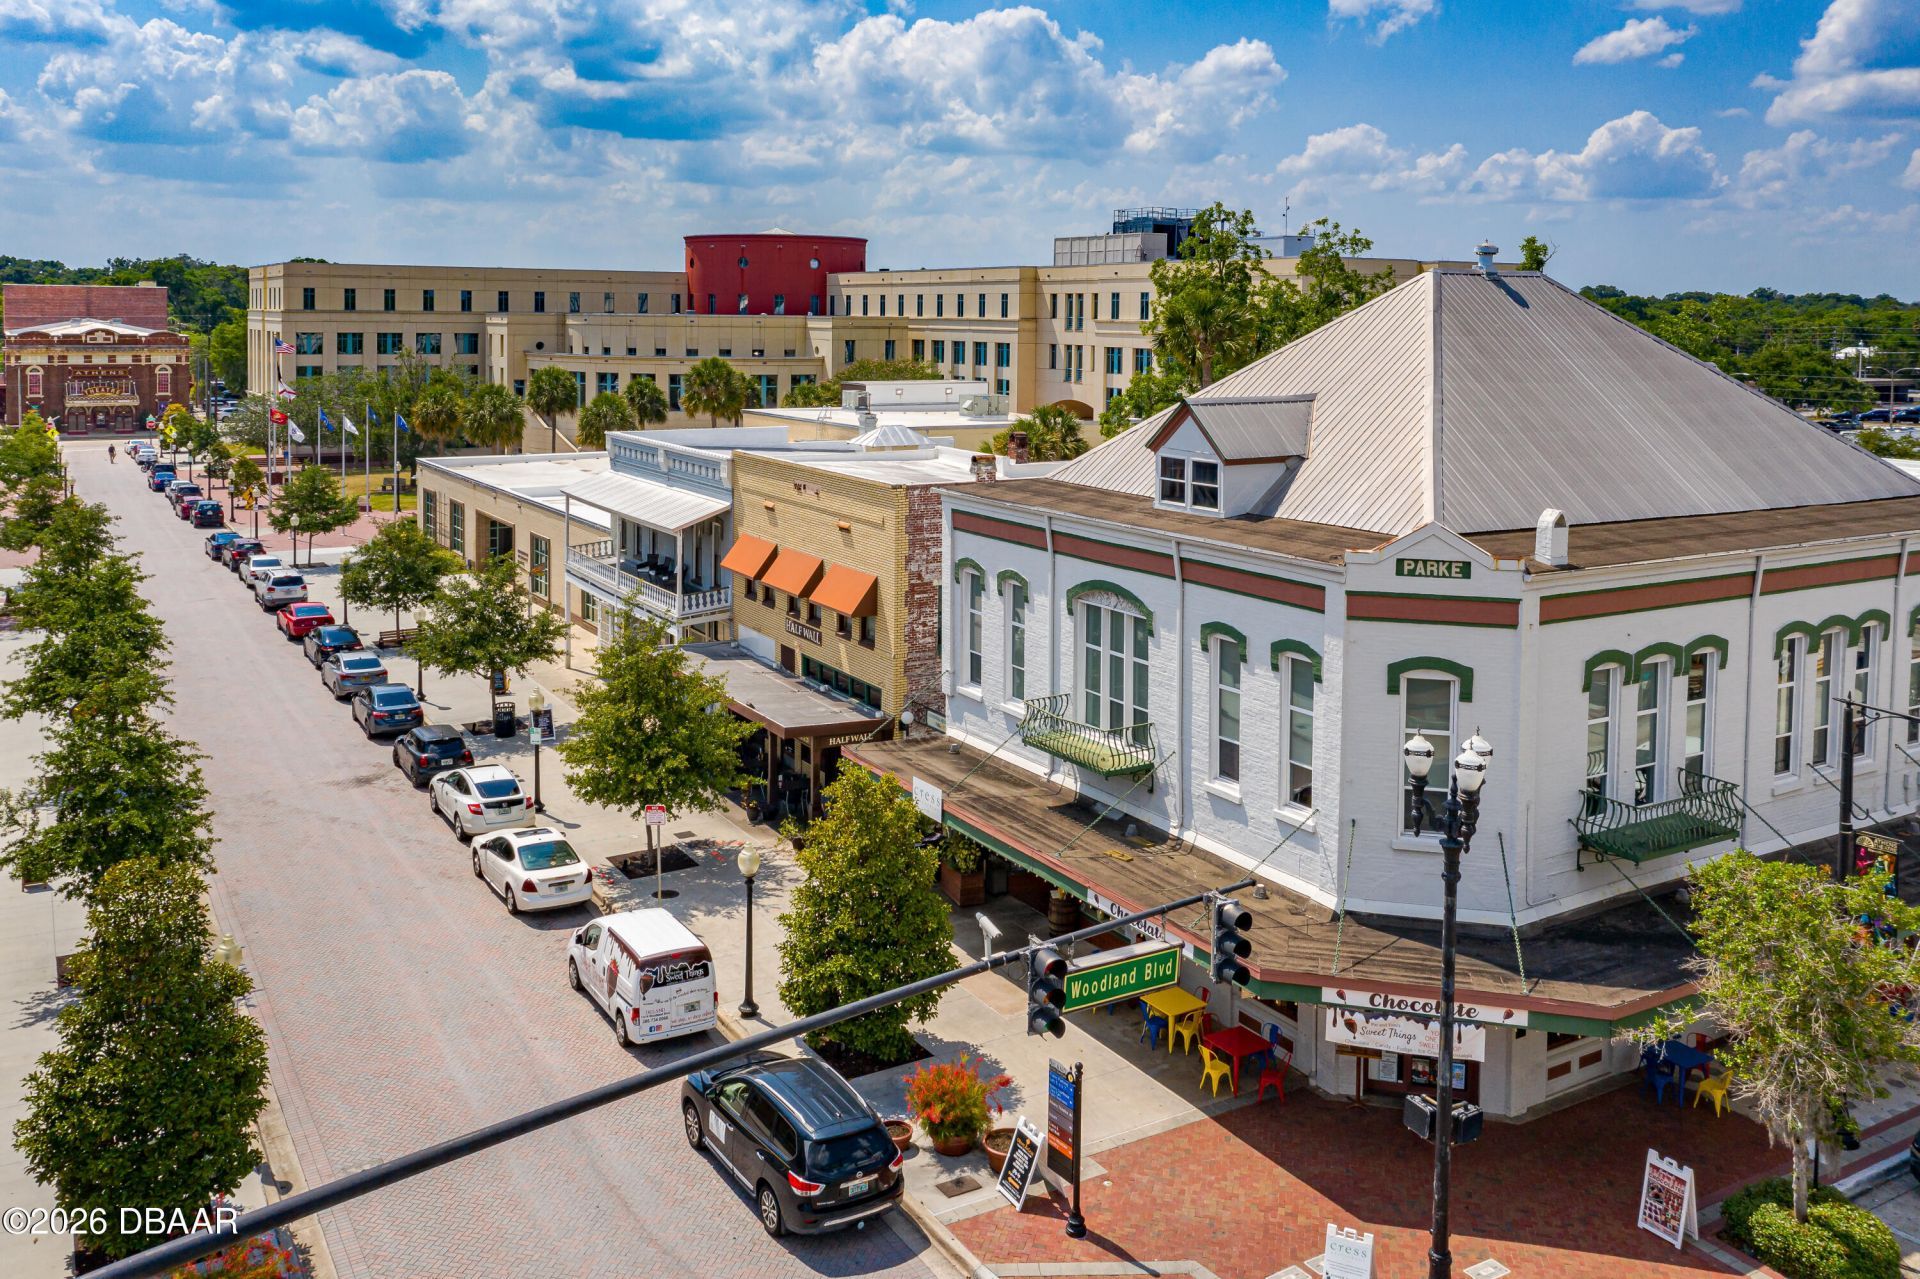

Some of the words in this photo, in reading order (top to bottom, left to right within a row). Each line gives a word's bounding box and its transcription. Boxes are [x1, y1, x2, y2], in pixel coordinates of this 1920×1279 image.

[84, 387, 121, 395] THEATRE
[1403, 559, 1463, 578] PARKE
[786, 620, 803, 636] HALF
[802, 627, 821, 645] WALL
[913, 786, 941, 807] cress
[684, 968, 705, 979] Things
[1071, 966, 1137, 999] Woodland
[1144, 958, 1173, 981] Blvd
[1369, 993, 1480, 1019] Chocolte
[1360, 1026, 1388, 1037] Sweet
[1388, 1027, 1417, 1045] Things
[1330, 1241, 1368, 1259] cress
